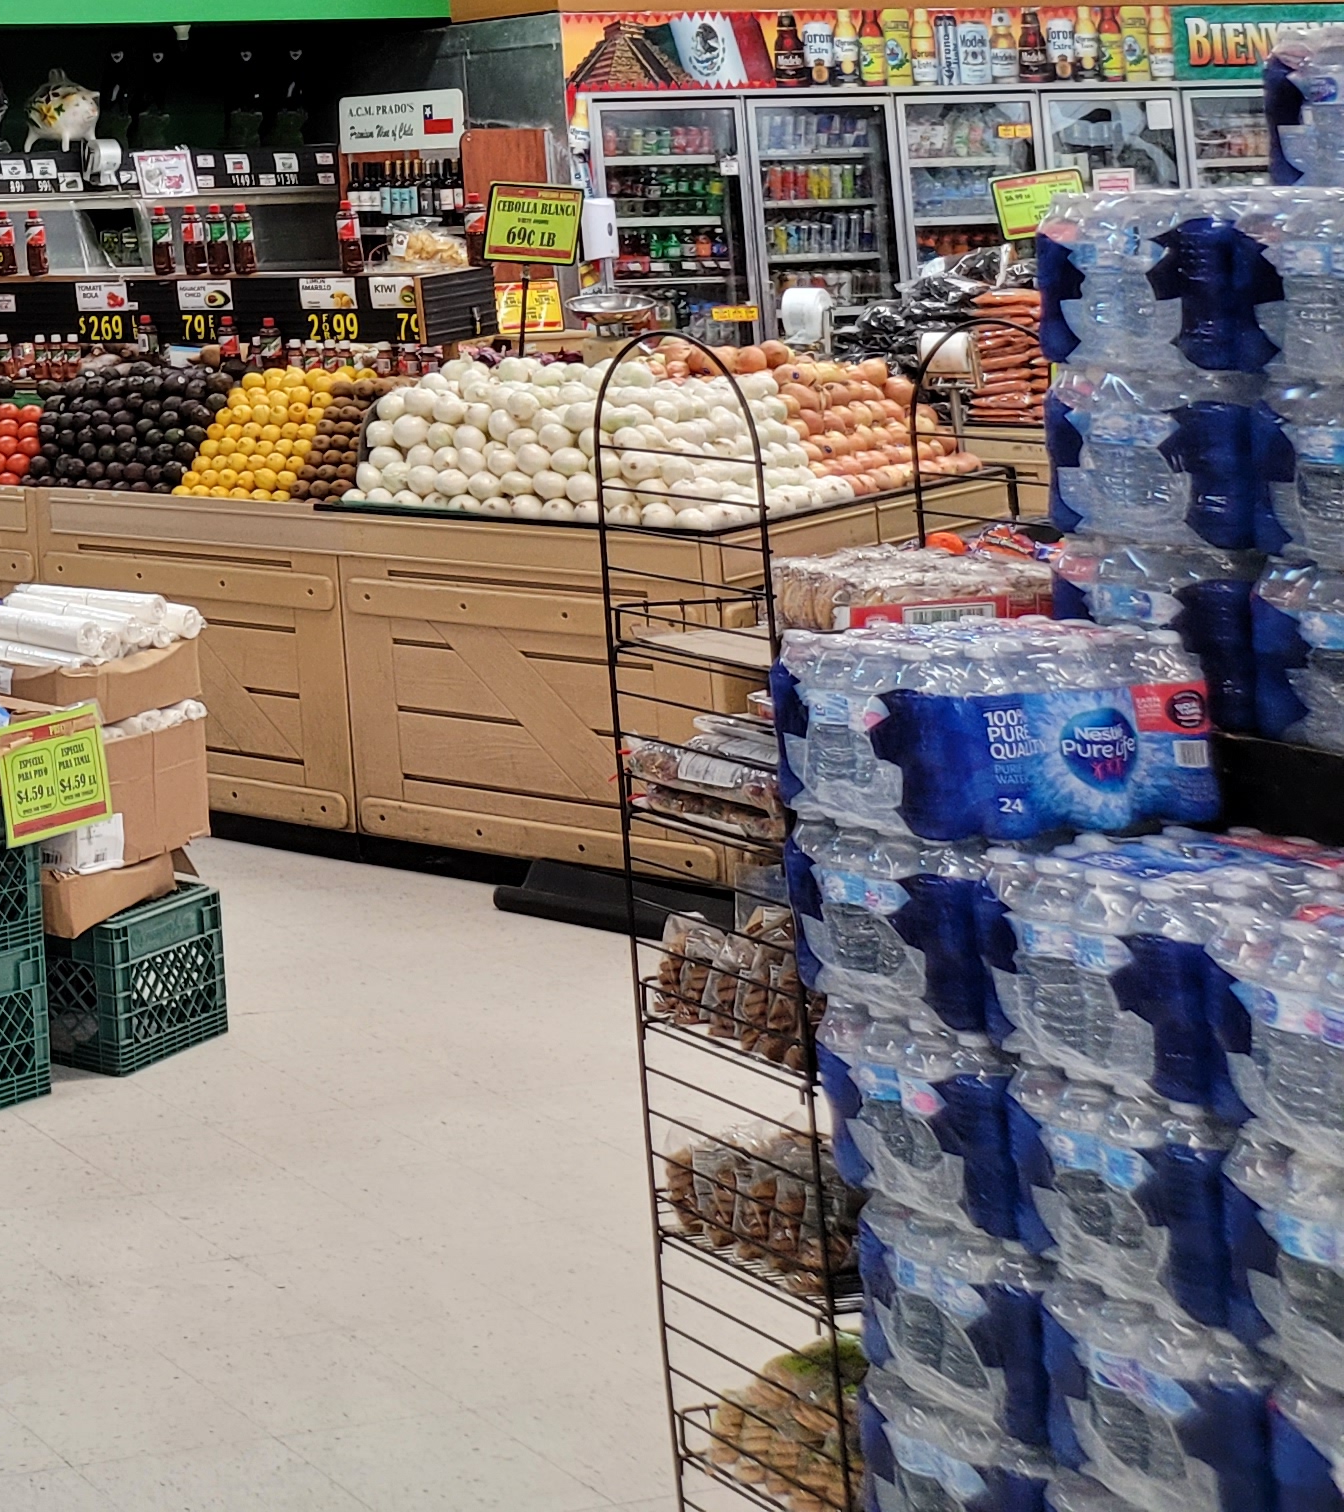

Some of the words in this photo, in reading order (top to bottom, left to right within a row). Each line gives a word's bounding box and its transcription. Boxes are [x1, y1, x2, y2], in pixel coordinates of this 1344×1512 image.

[809, 45, 829, 54] Extra
[1185, 17, 1328, 67] BIENV
[497, 200, 538, 215] CEBOLLA
[541, 203, 576, 217] BLANCA
[506, 226, 535, 248] 69¢
[539, 231, 556, 247] LB
[78, 285, 102, 293] TOMATE
[374, 284, 397, 294] KIWI
[987, 725, 1031, 742] PURE
[990, 740, 1047, 760] QUALITY
[1062, 739, 1114, 758] Pure
[18, 770, 33, 783] PARA
[59, 773, 86, 794] $4.59
[16, 784, 44, 805] $4.59
[999, 798, 1024, 814] 24
